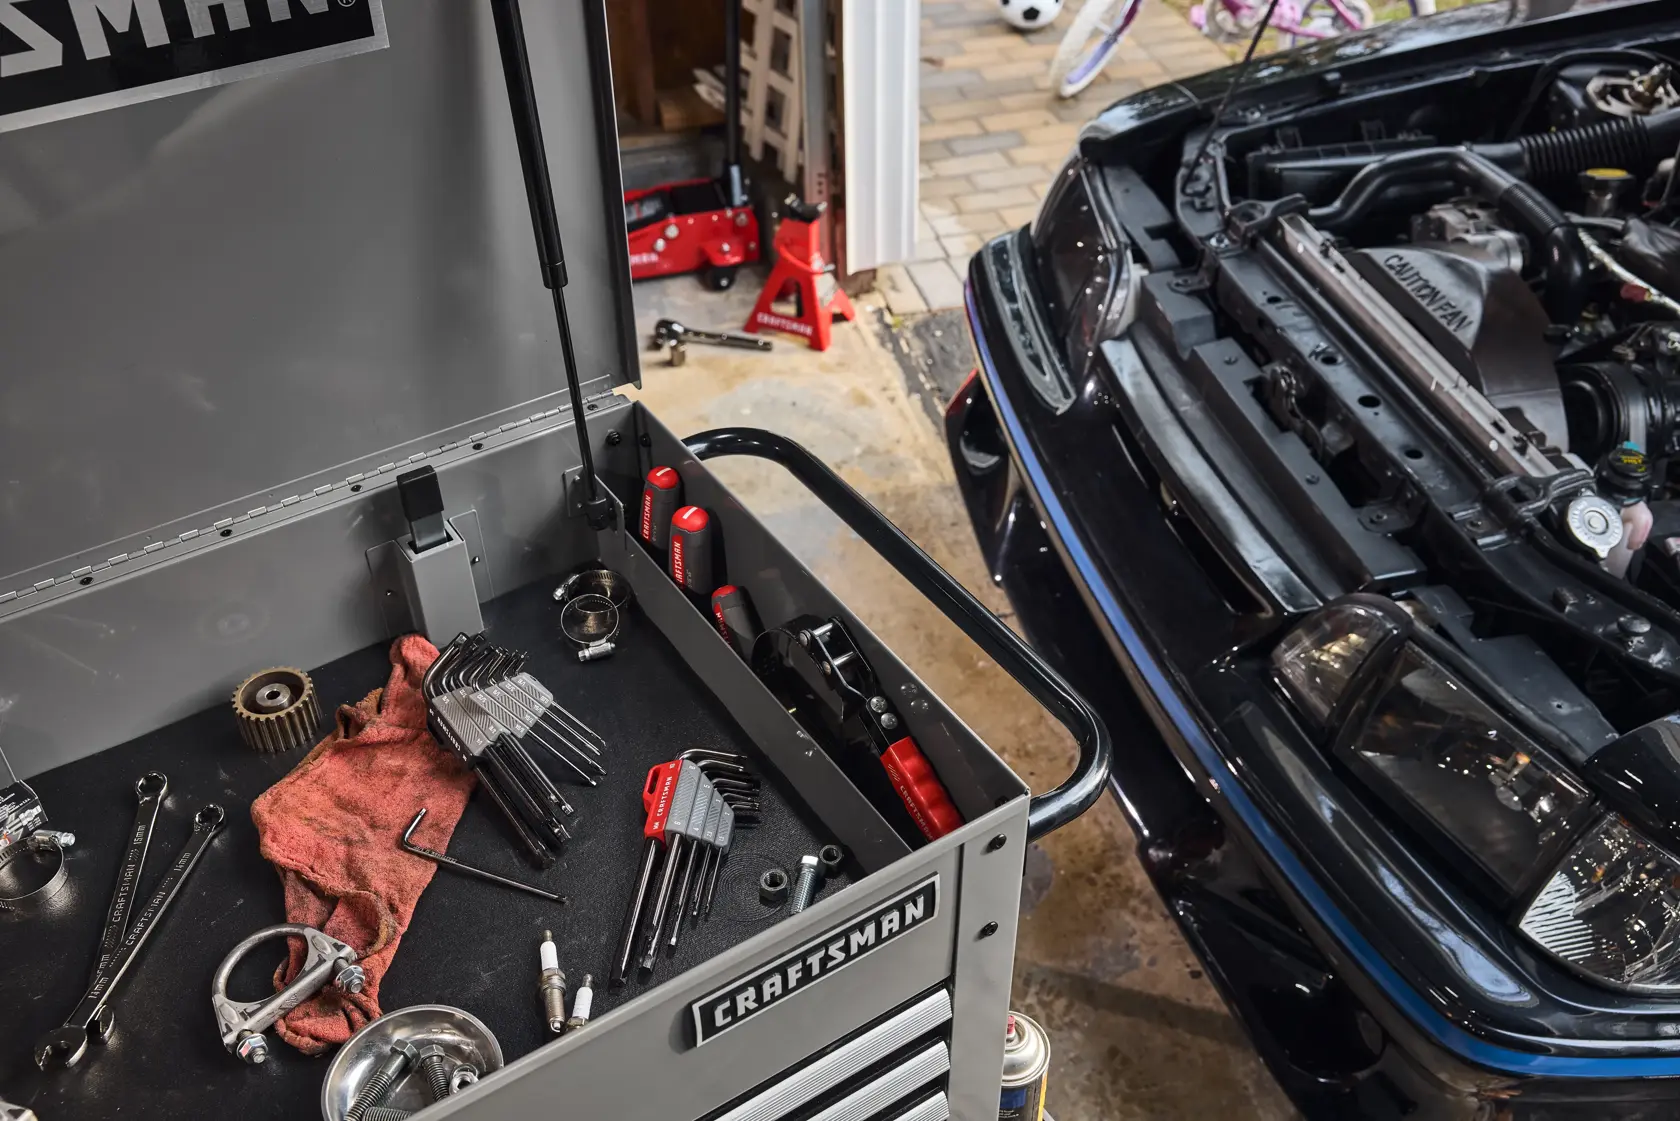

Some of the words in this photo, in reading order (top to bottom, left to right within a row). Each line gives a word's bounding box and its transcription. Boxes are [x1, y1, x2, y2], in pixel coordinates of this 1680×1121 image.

[657, 776, 673, 817] CRAFTSMAN
[88, 976, 109, 999] 14mm
[125, 891, 166, 946] CRAFTSMAN
[173, 851, 191, 872] 14mm
[112, 864, 136, 923] CRAFTSMAN
[714, 894, 925, 1028] CRAFTSMAN
